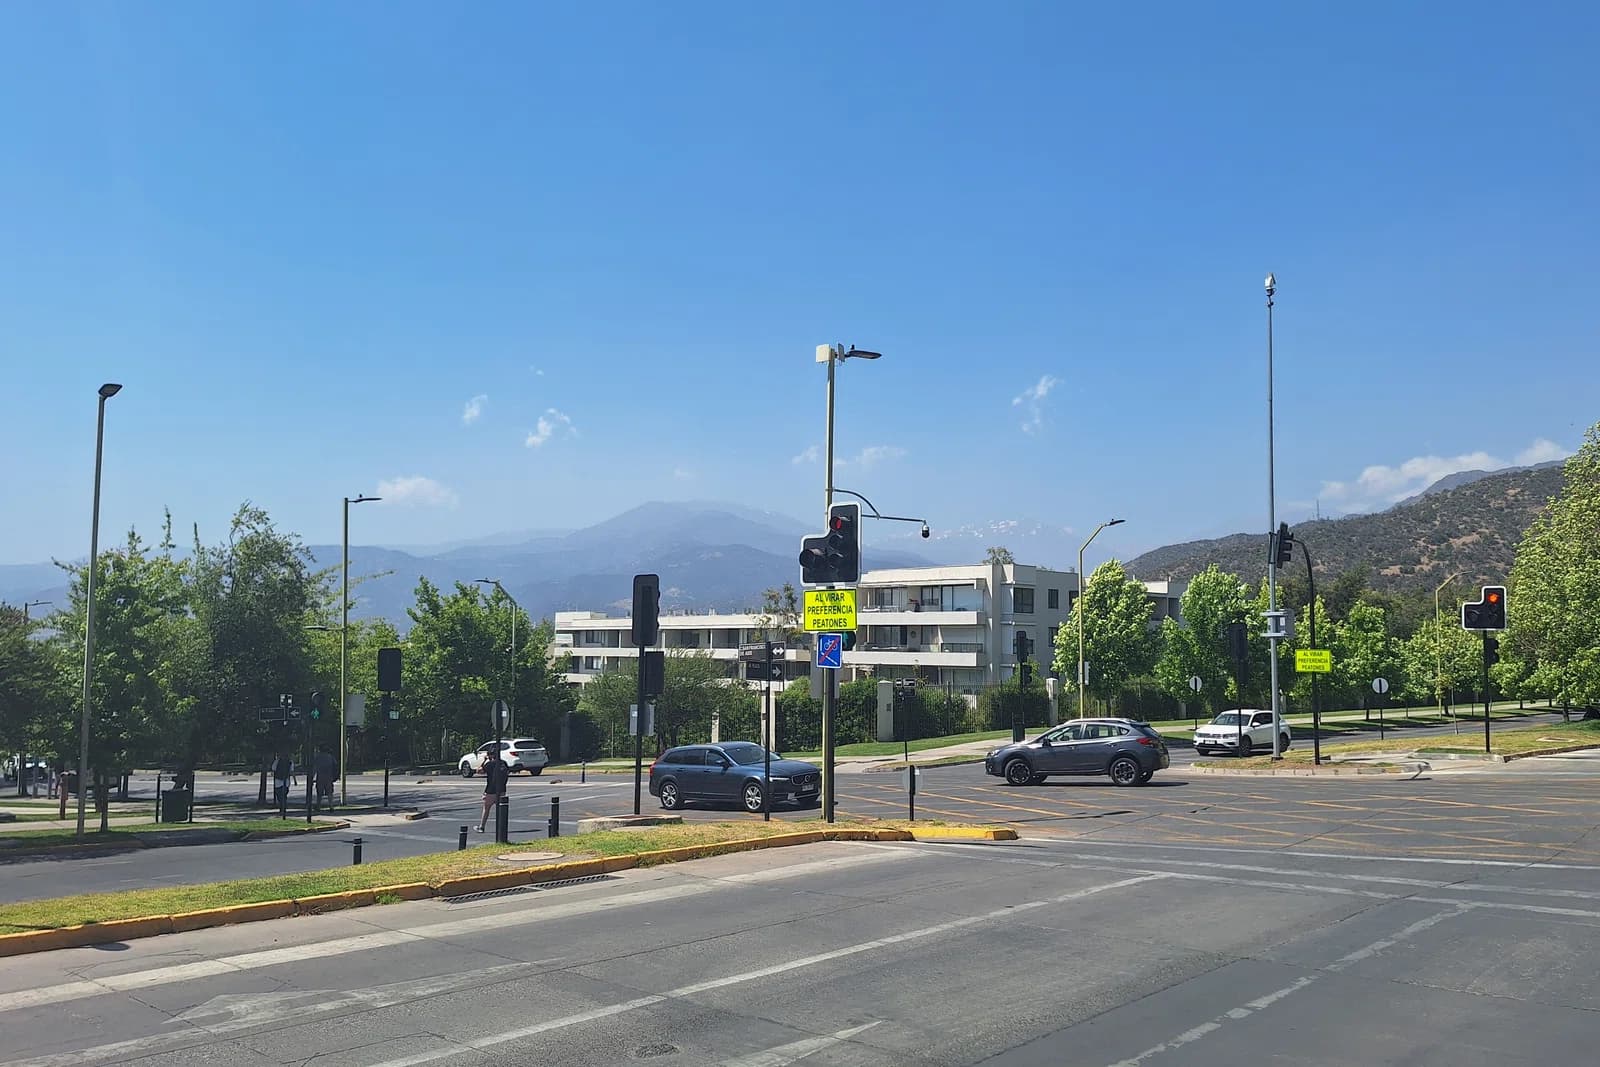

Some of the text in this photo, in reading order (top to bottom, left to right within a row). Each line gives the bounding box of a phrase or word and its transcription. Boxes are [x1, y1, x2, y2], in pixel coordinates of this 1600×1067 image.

[815, 592, 845, 602] AL VIRAR
[807, 605, 854, 615] PREFERENCIA
[813, 618, 848, 628] PEATONES
